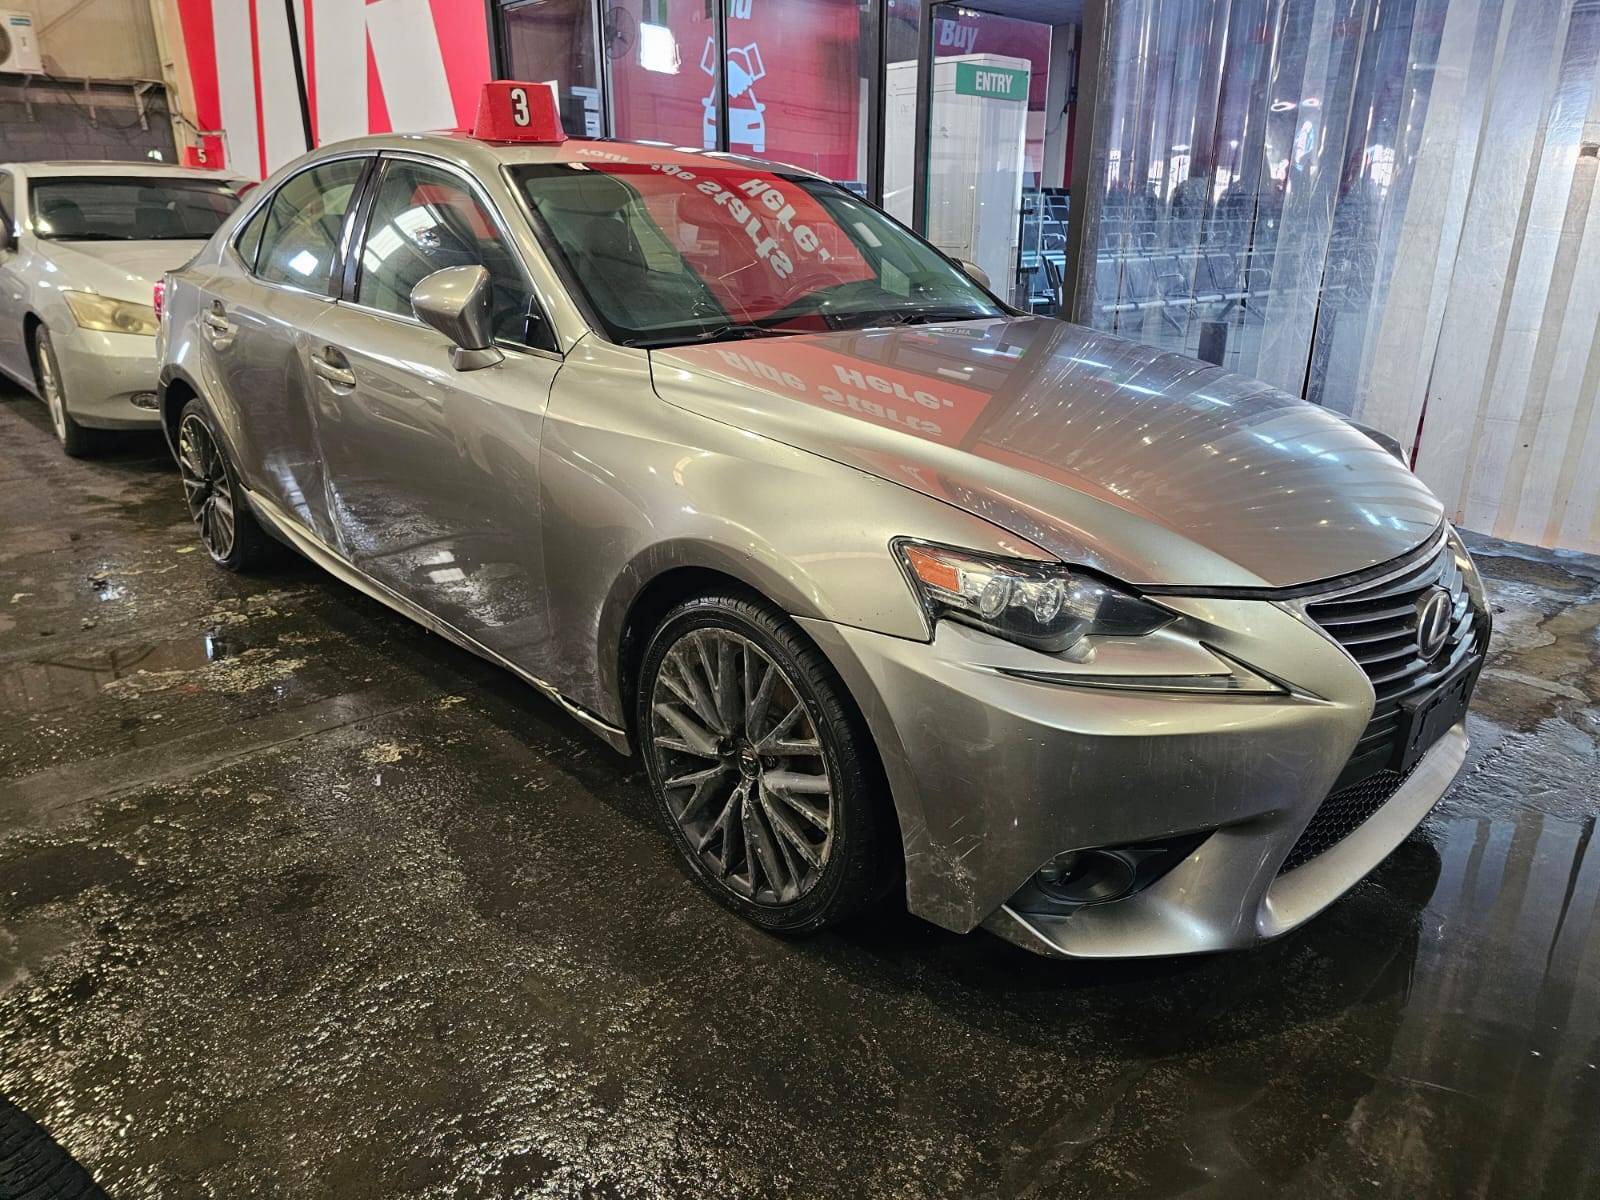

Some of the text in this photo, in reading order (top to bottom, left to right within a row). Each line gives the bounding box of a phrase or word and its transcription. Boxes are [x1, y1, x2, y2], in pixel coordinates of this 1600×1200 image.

[939, 19, 979, 54] Buy
[975, 70, 1014, 94] ENTRY
[511, 88, 530, 127] 3
[197, 148, 208, 164] 5
